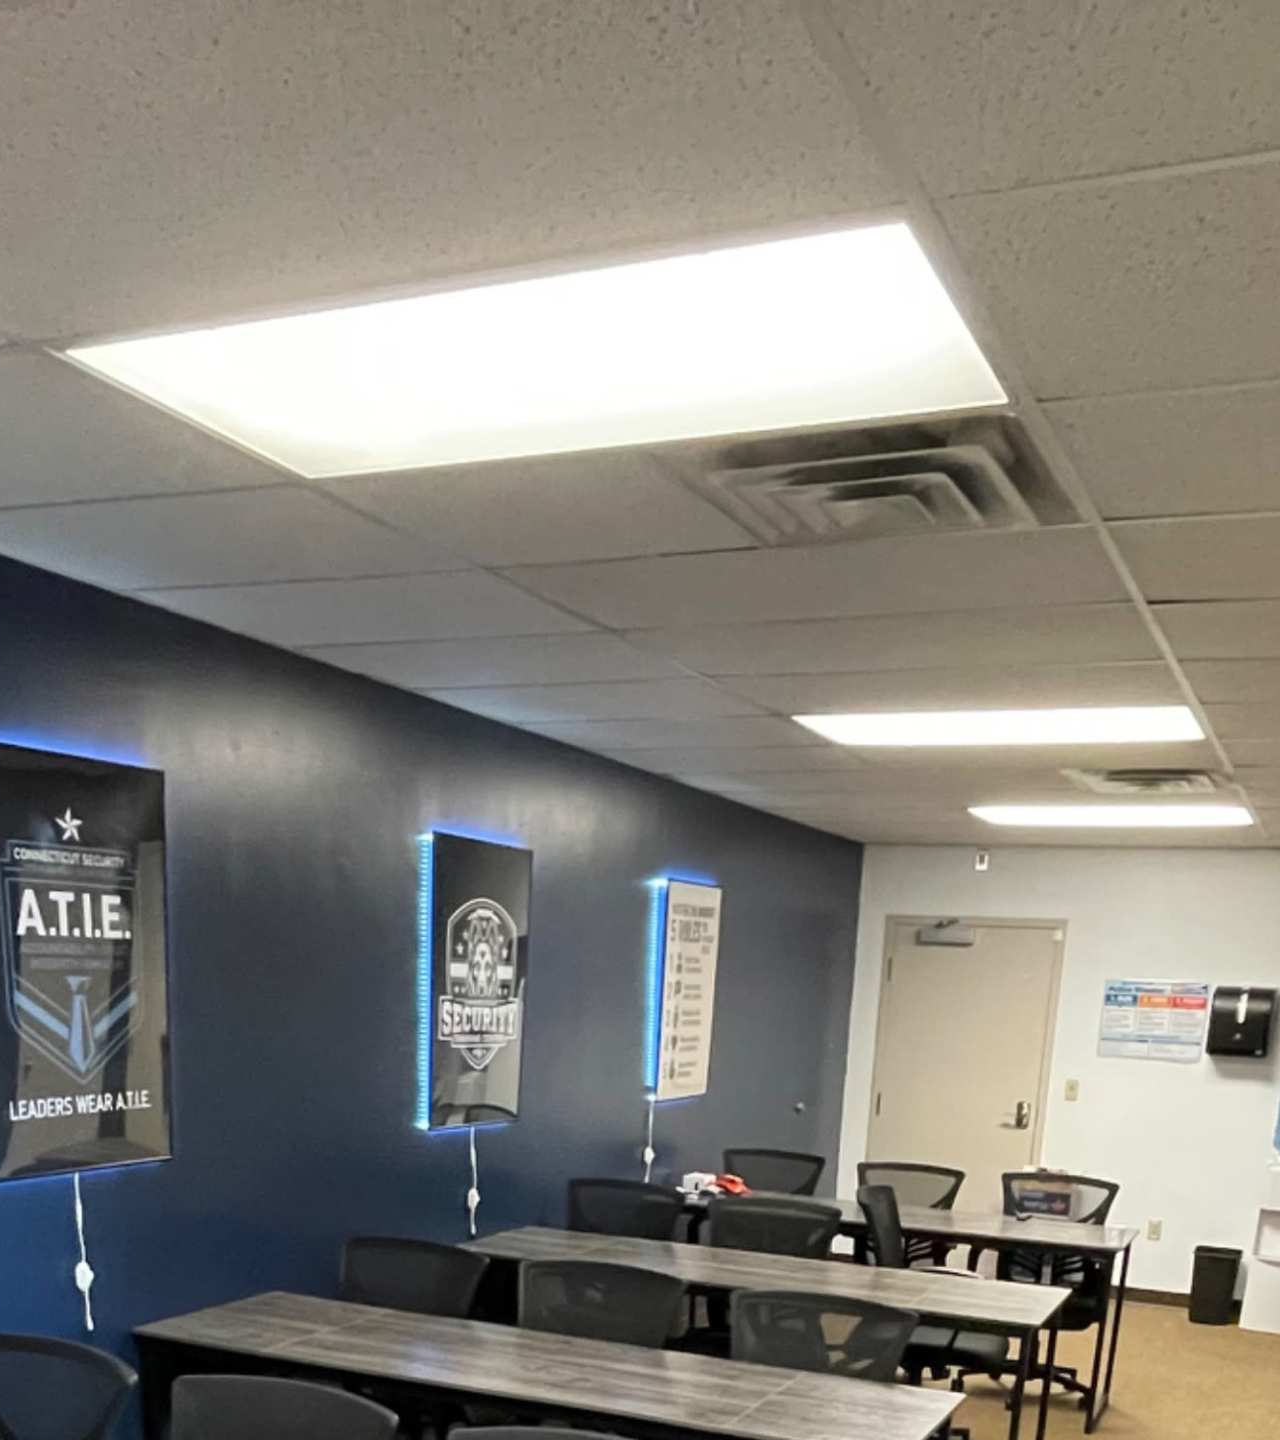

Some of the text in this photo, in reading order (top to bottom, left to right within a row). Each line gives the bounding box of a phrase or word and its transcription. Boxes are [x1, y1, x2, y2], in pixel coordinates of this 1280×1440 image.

[13, 847, 125, 868] CONNECTICUT SECURITY
[16, 888, 131, 940] A.T.I.E.
[442, 1001, 515, 1036] SECURITY
[9, 1096, 73, 1121] LEADERS
[75, 1093, 113, 1115] WEAR
